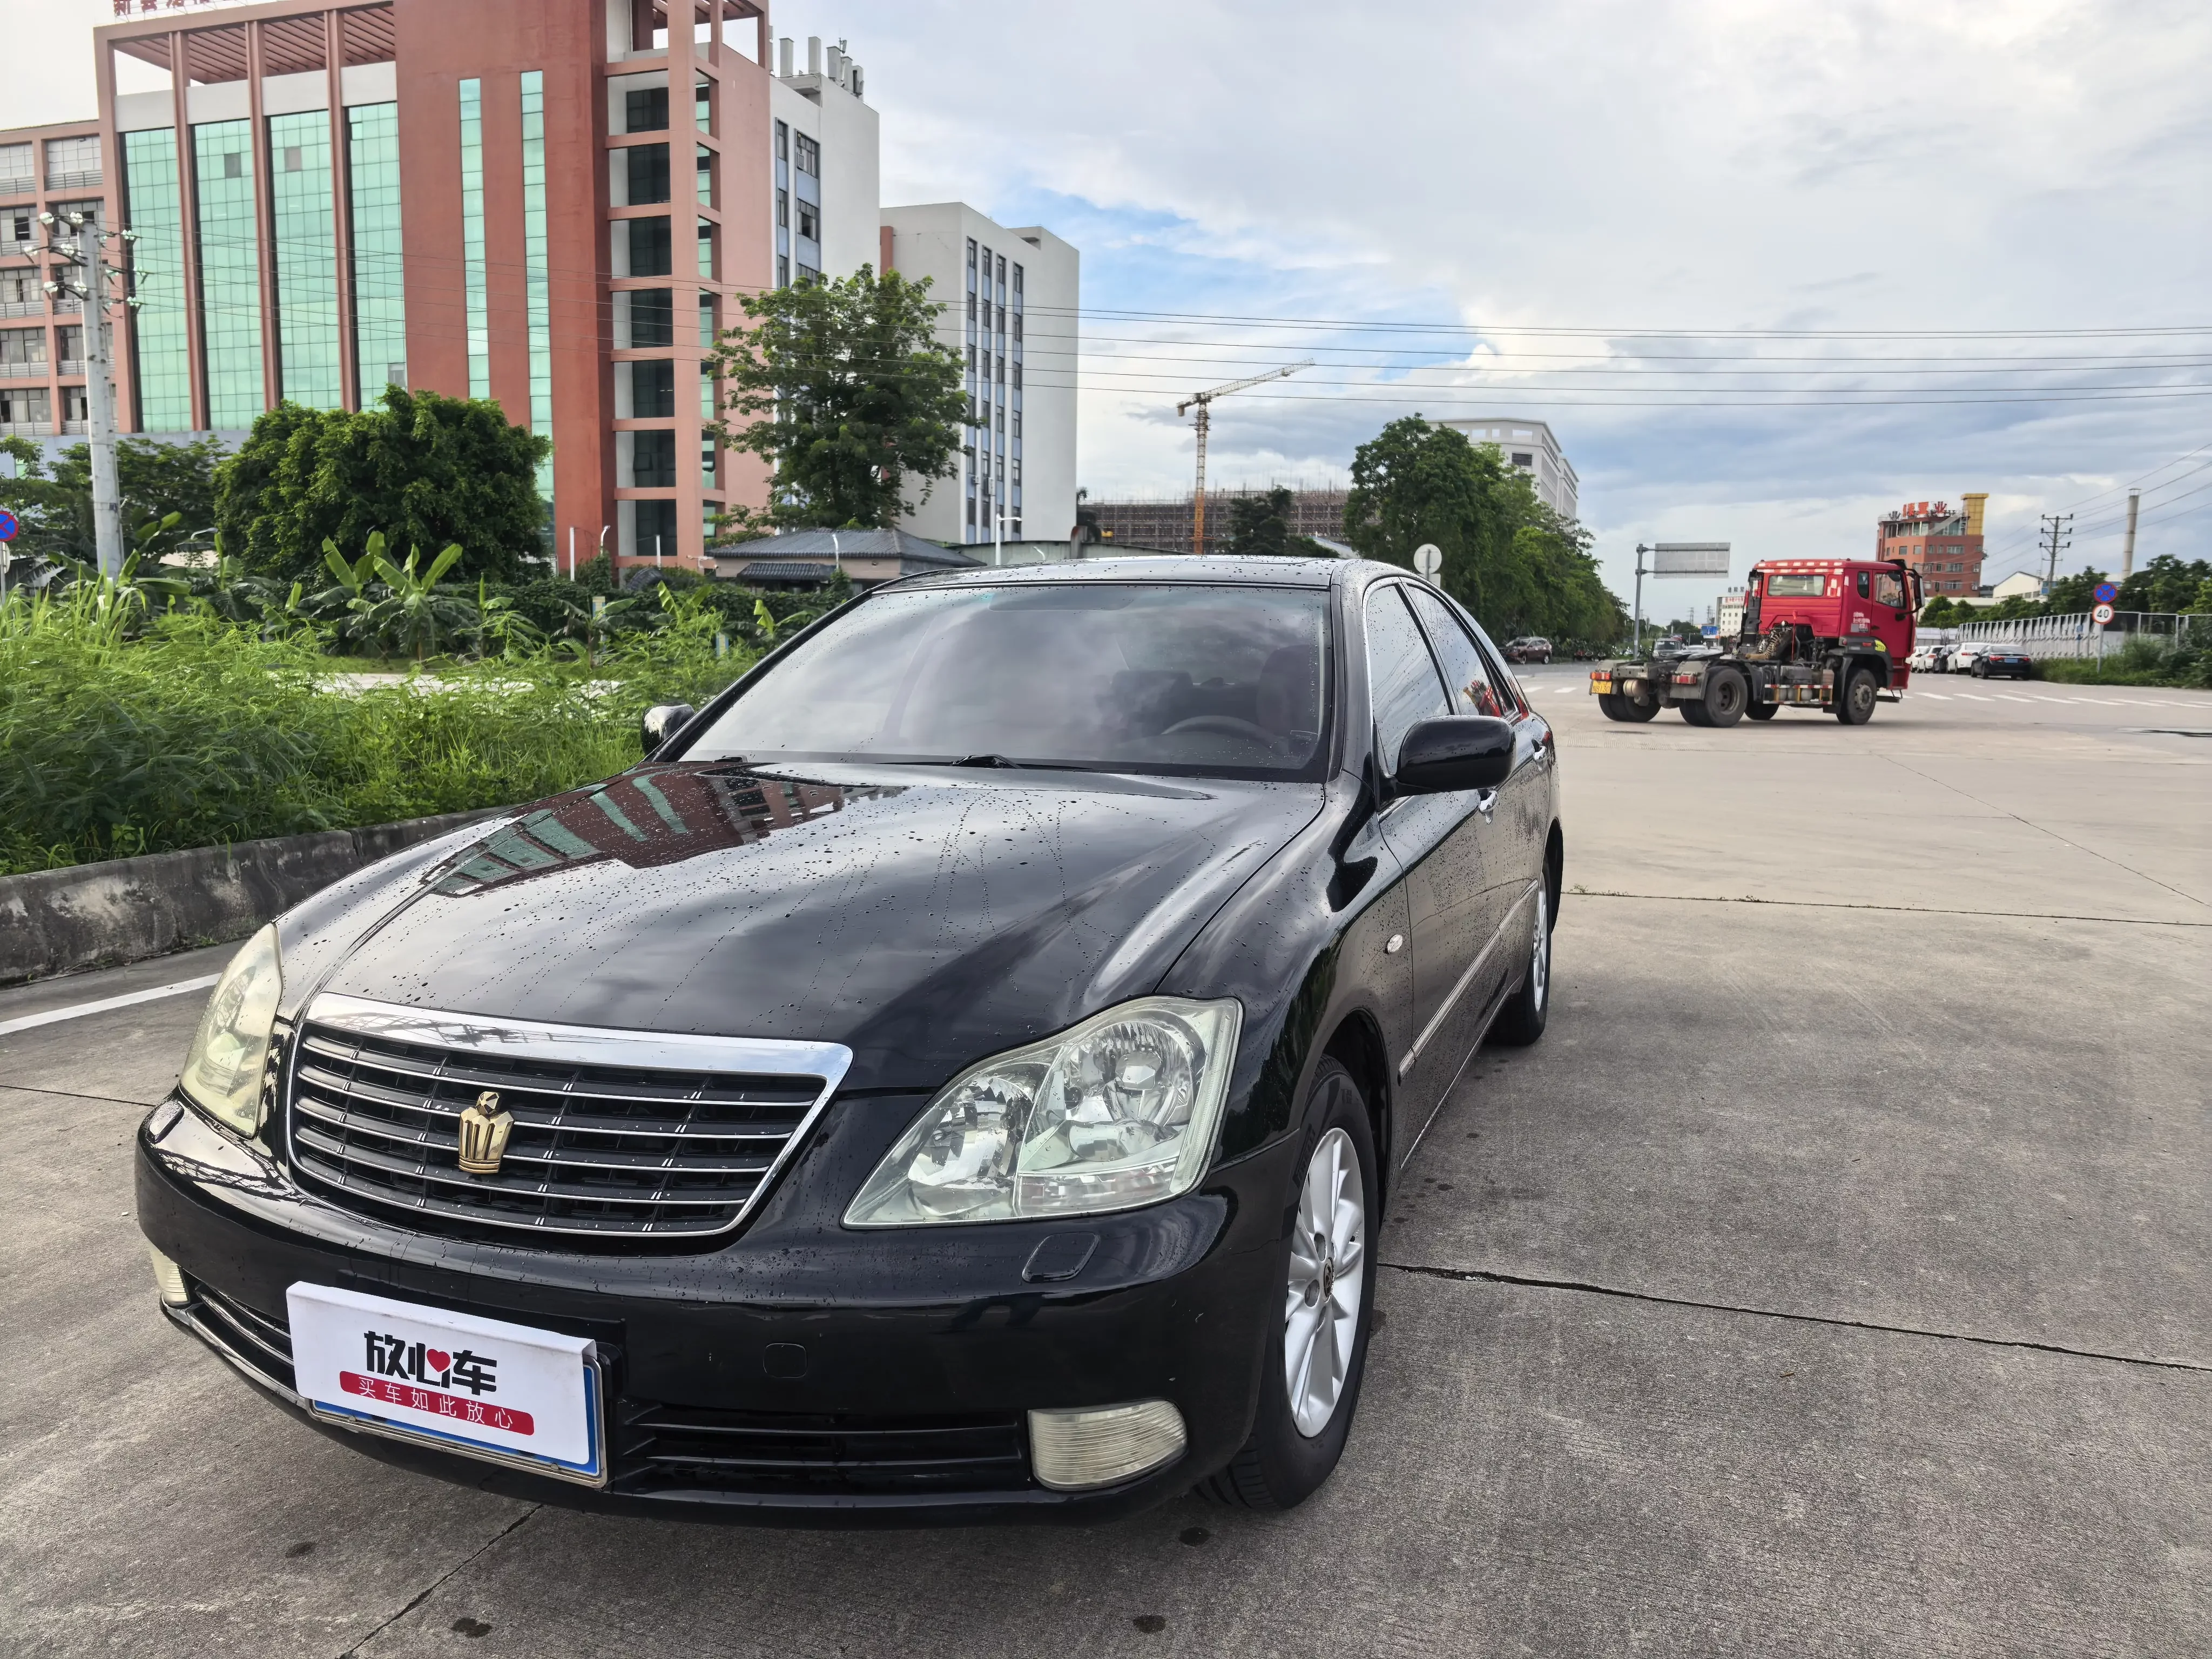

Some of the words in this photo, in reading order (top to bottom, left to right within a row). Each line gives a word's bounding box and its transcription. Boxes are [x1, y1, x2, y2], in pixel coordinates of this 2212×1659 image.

[2097, 609, 2109, 618] 40
[364, 1331, 497, 1395] 放心车
[359, 1378, 512, 1429] 买车如此放心
